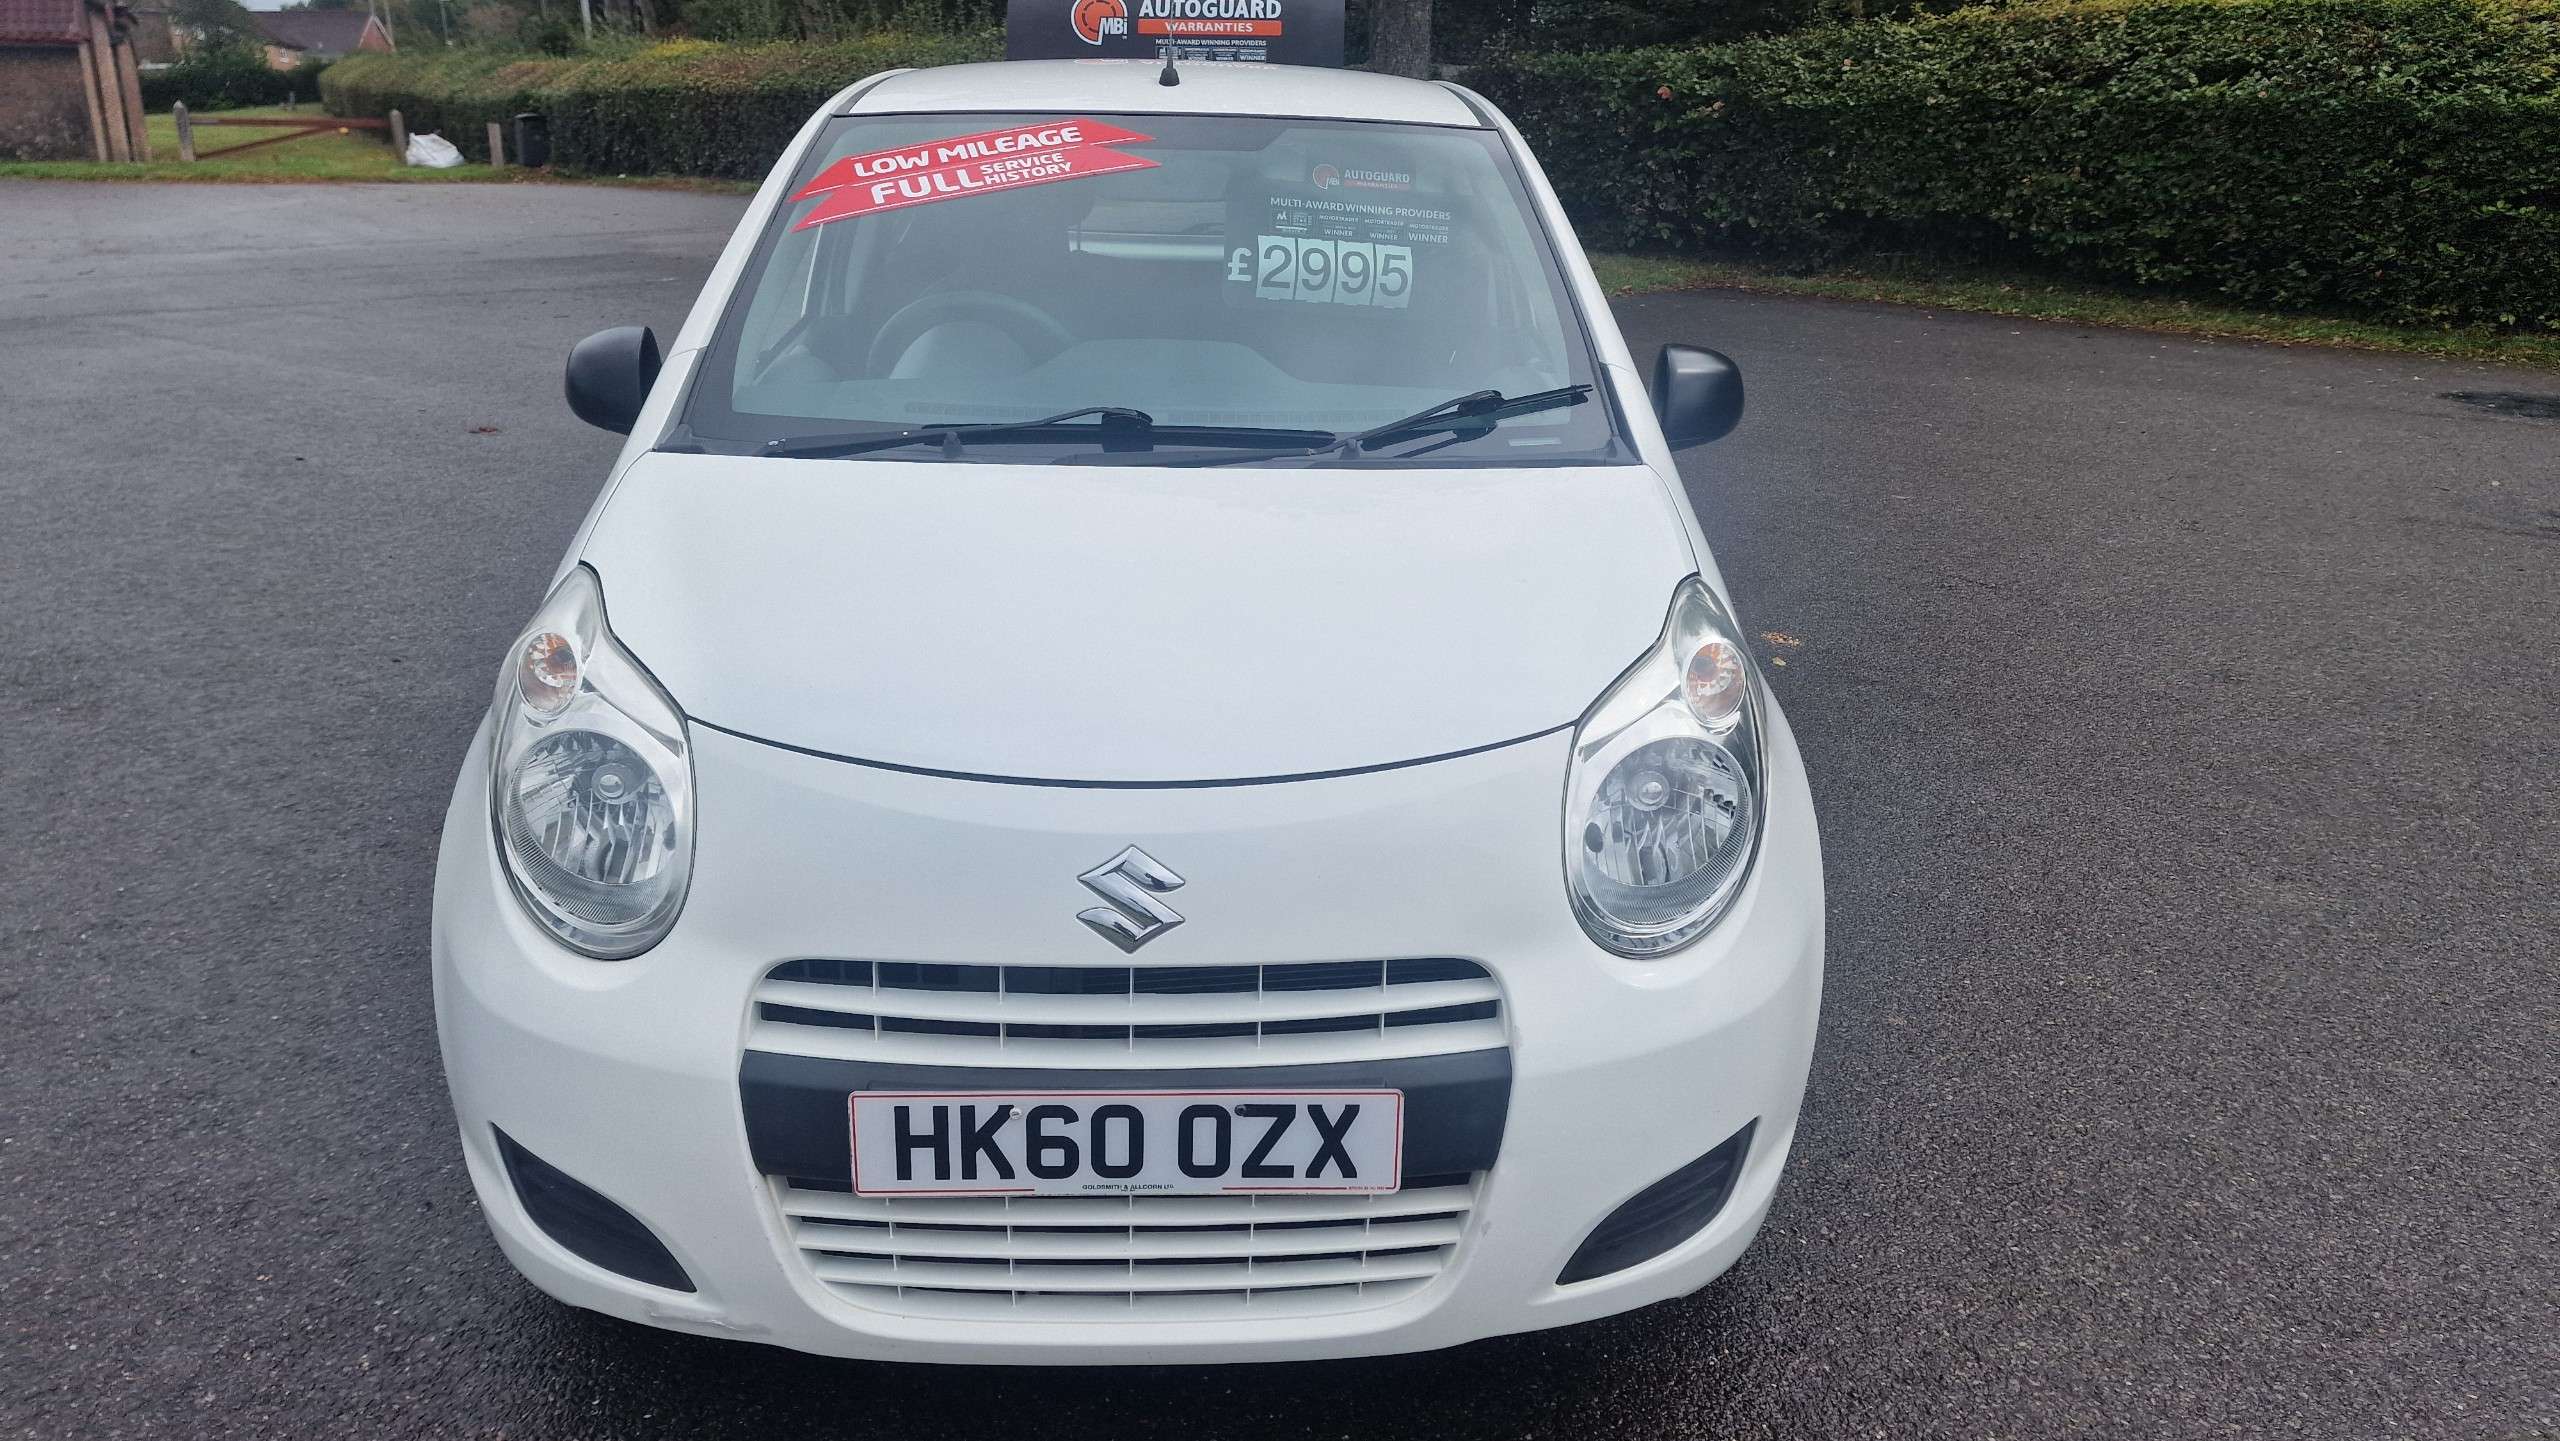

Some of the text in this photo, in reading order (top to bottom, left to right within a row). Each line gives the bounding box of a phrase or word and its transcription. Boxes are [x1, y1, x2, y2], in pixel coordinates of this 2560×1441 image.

[1138, 0, 1282, 18] AUTOGUARD
[1165, 22, 1254, 33] WARRANTIES
[854, 126, 1084, 177] LOW MILEAGE
[981, 151, 1065, 175] SERVICE
[984, 162, 1072, 185] HISTORY
[1344, 169, 1410, 183] AUTOGUARD
[871, 168, 985, 204] FULL
[1270, 197, 1450, 221] MULTI-AWARD WINNING PROVIDERS
[1324, 228, 1353, 237] WINNER
[1369, 231, 1398, 241] WINNER
[1408, 232, 1449, 244] WINNER
[1228, 244, 1409, 297] £2995
[893, 1104, 1361, 1181] HK60 OZX
